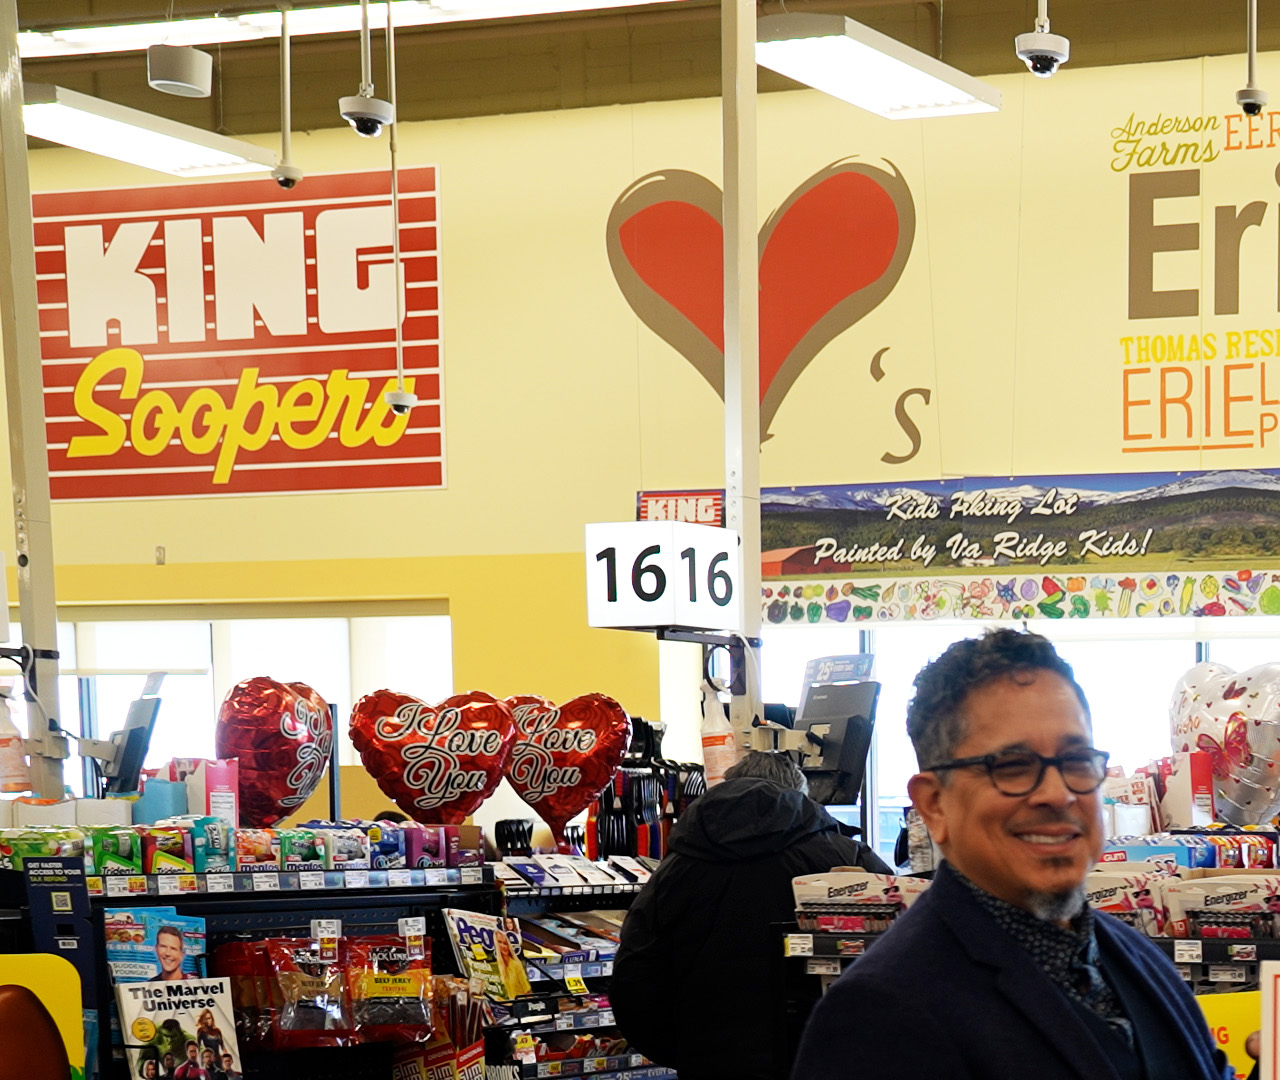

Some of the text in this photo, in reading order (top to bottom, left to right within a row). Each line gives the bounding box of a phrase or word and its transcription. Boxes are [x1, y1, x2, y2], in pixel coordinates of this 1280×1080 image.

[1111, 112, 1220, 140] Anderson
[1110, 138, 1220, 172] Farms
[64, 207, 406, 349] KING
[1120, 332, 1217, 365] THOMAS
[66, 347, 416, 484] Soopers
[1122, 362, 1255, 442] ERIE
[647, 496, 718, 523] KING
[886, 487, 1080, 521] Kids Lot
[814, 535, 903, 565] Painted
[910, 533, 937, 567] by
[993, 530, 1068, 567] Ridge
[1077, 527, 1154, 558] Kids!
[595, 544, 667, 603] 16
[680, 547, 734, 607] 16
[403, 705, 502, 760] Love
[402, 751, 487, 809] You
[511, 750, 581, 802] You
[102, 865, 136, 875] Trident
[156, 865, 186, 875] Trident
[240, 862, 279, 872] mentos
[286, 861, 323, 871] mentos
[333, 860, 369, 870] mentos
[1103, 852, 1126, 863] GUM
[827, 880, 869, 898] Energizer
[1203, 889, 1247, 908] Energizer
[128, 981, 224, 1000] The Marvel
[143, 997, 216, 1013] Universe
